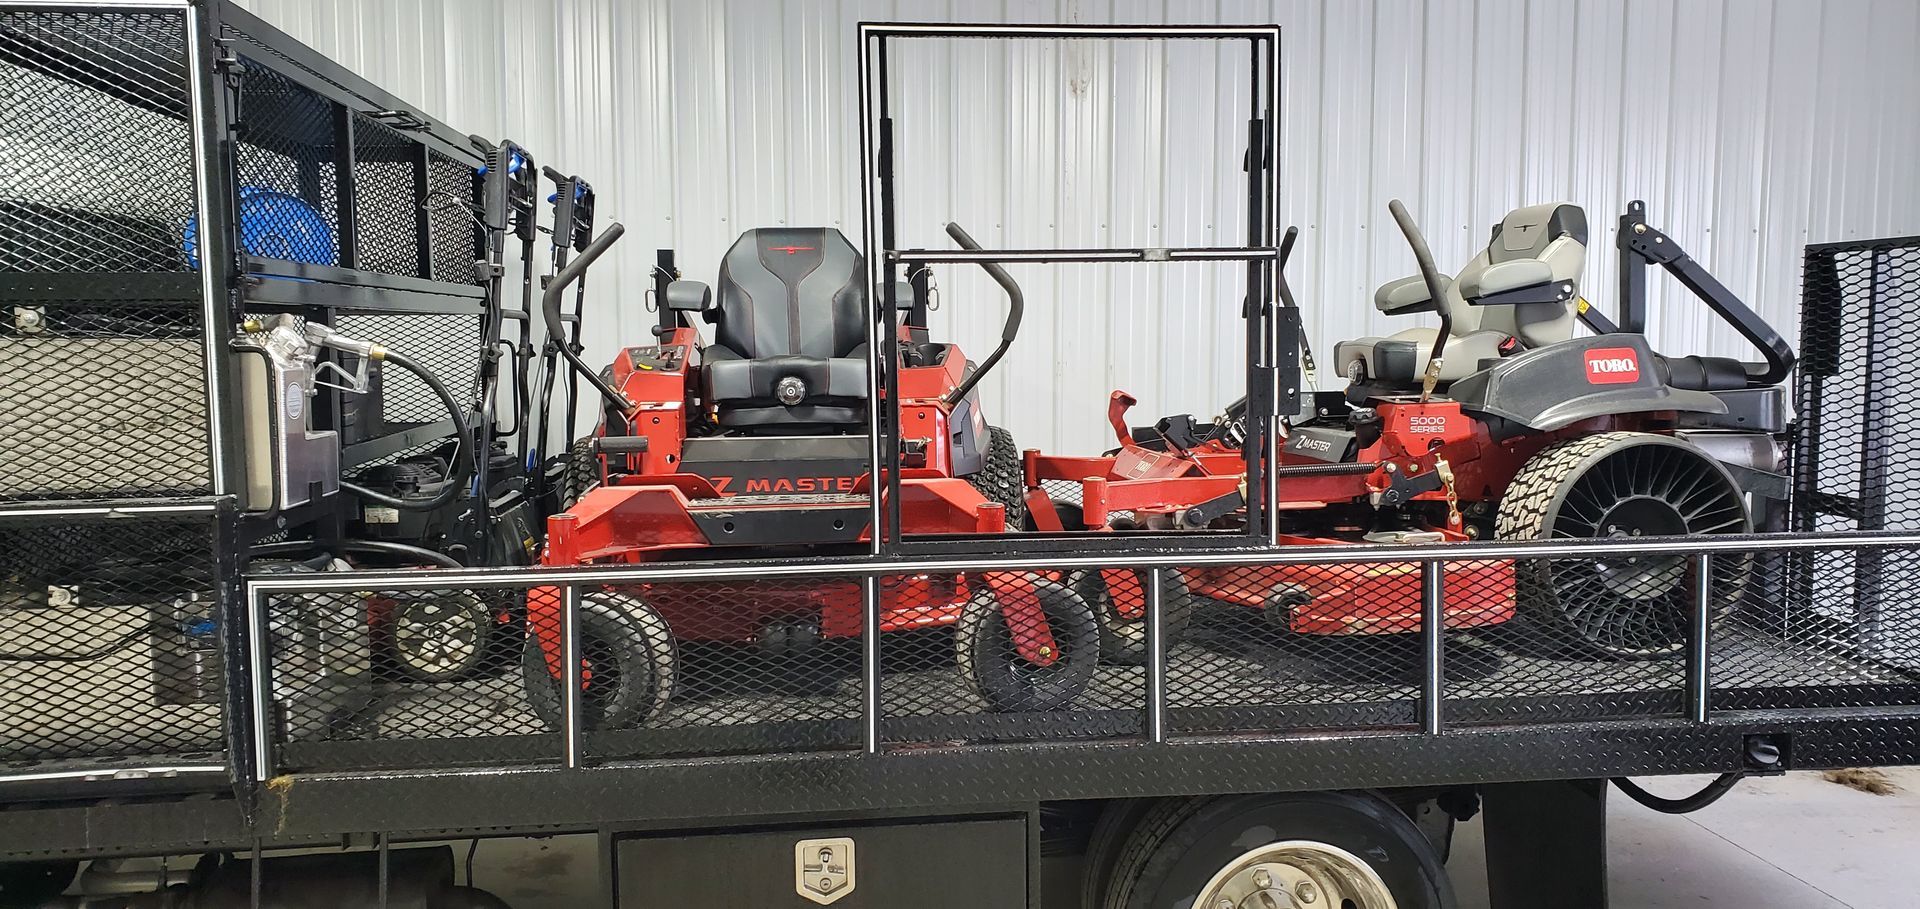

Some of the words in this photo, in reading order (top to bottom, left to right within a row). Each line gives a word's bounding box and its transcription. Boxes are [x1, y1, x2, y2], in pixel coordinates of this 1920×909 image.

[1410, 416, 1446, 425] 5000
[1410, 425, 1445, 433] SERIES
[1295, 434, 1306, 449] Z
[1302, 438, 1331, 452] MASTER
[710, 477, 738, 497] Z
